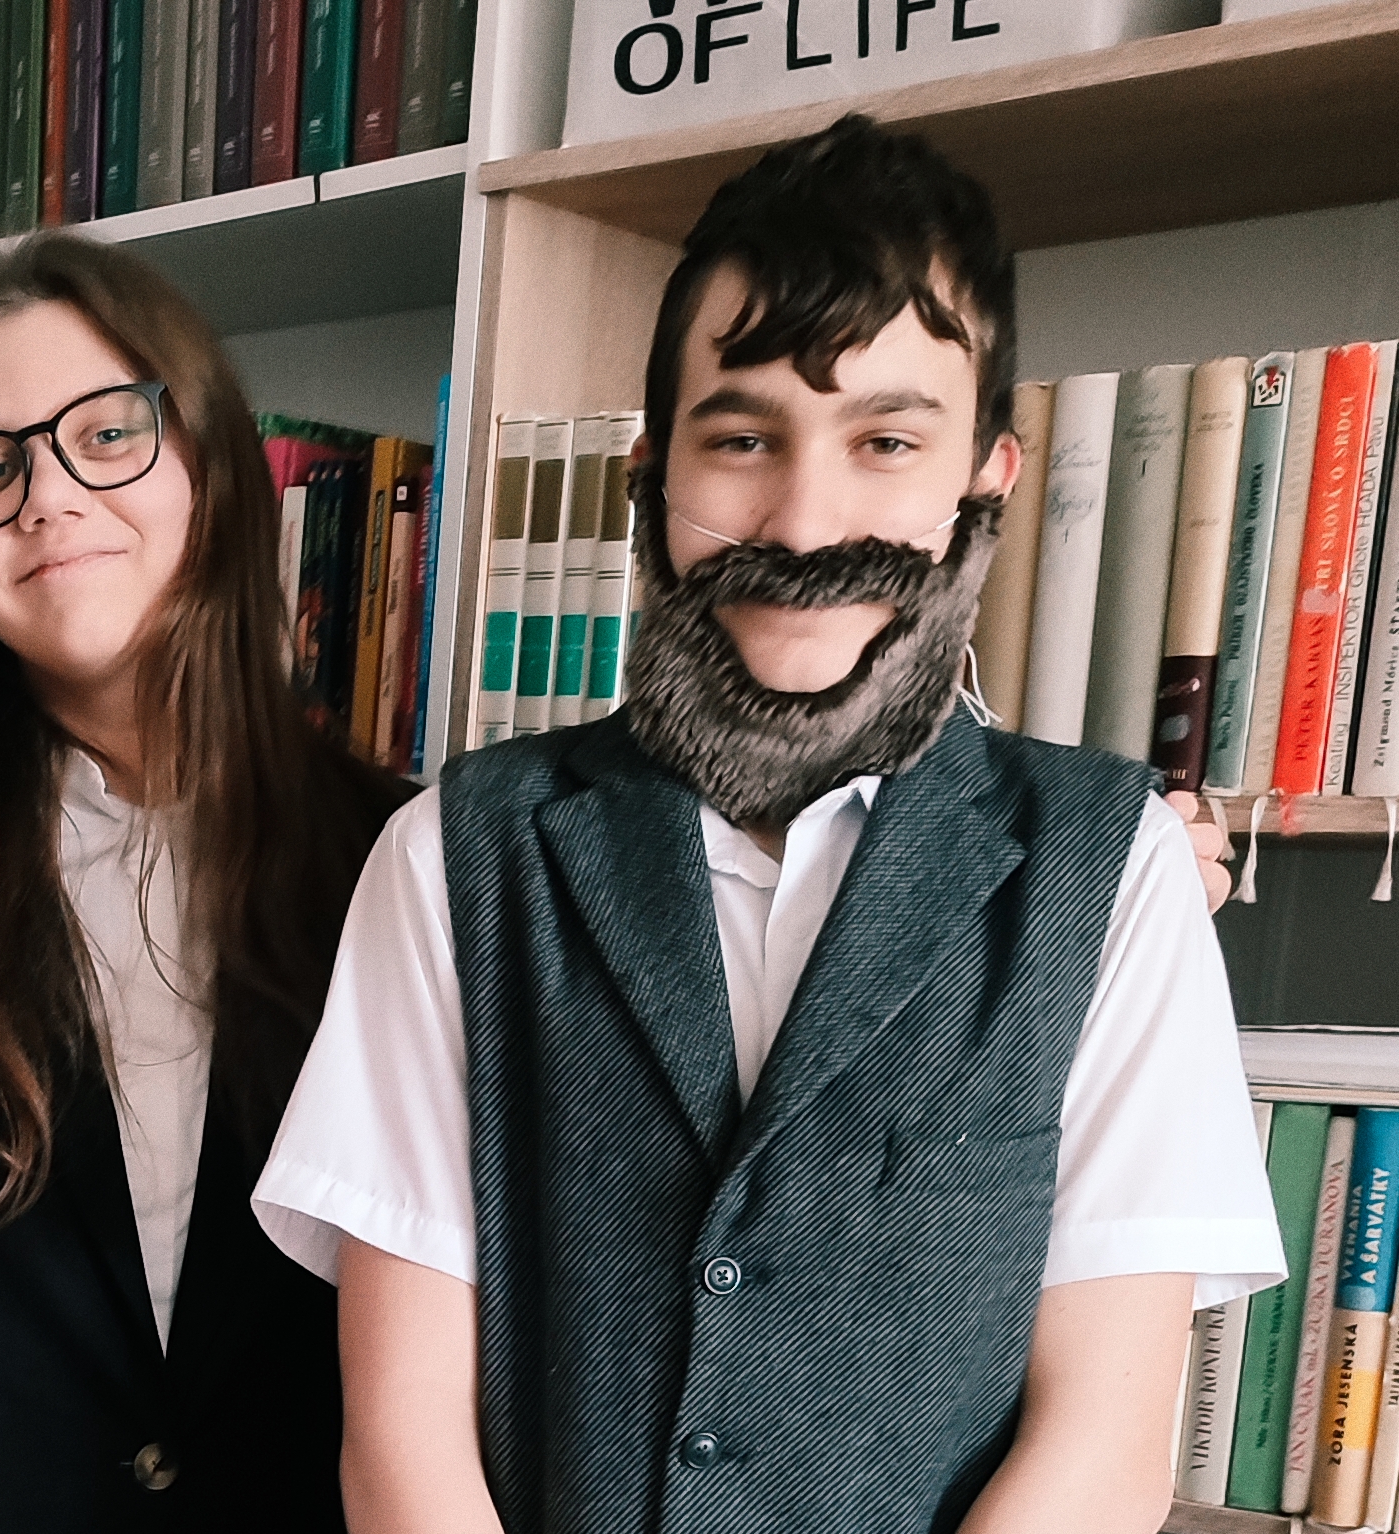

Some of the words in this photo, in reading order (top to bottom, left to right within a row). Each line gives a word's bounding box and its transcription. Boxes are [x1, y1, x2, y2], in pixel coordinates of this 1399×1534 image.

[613, 1, 763, 95] OF
[786, 0, 1001, 70] LIFE
[1333, 396, 1356, 460] SRDCI
[1329, 466, 1346, 480] O
[1336, 596, 1361, 701] INSPEKTOR
[1295, 699, 1315, 761] PETER
[1325, 723, 1348, 787] Keating
[1372, 699, 1393, 768] Zsigmond
[1365, 1166, 1391, 1267] ŠARVÁTKY
[1360, 1269, 1377, 1285] A
[1190, 1399, 1215, 1470] VIKTOR
[1329, 1417, 1348, 1467] ZORA
